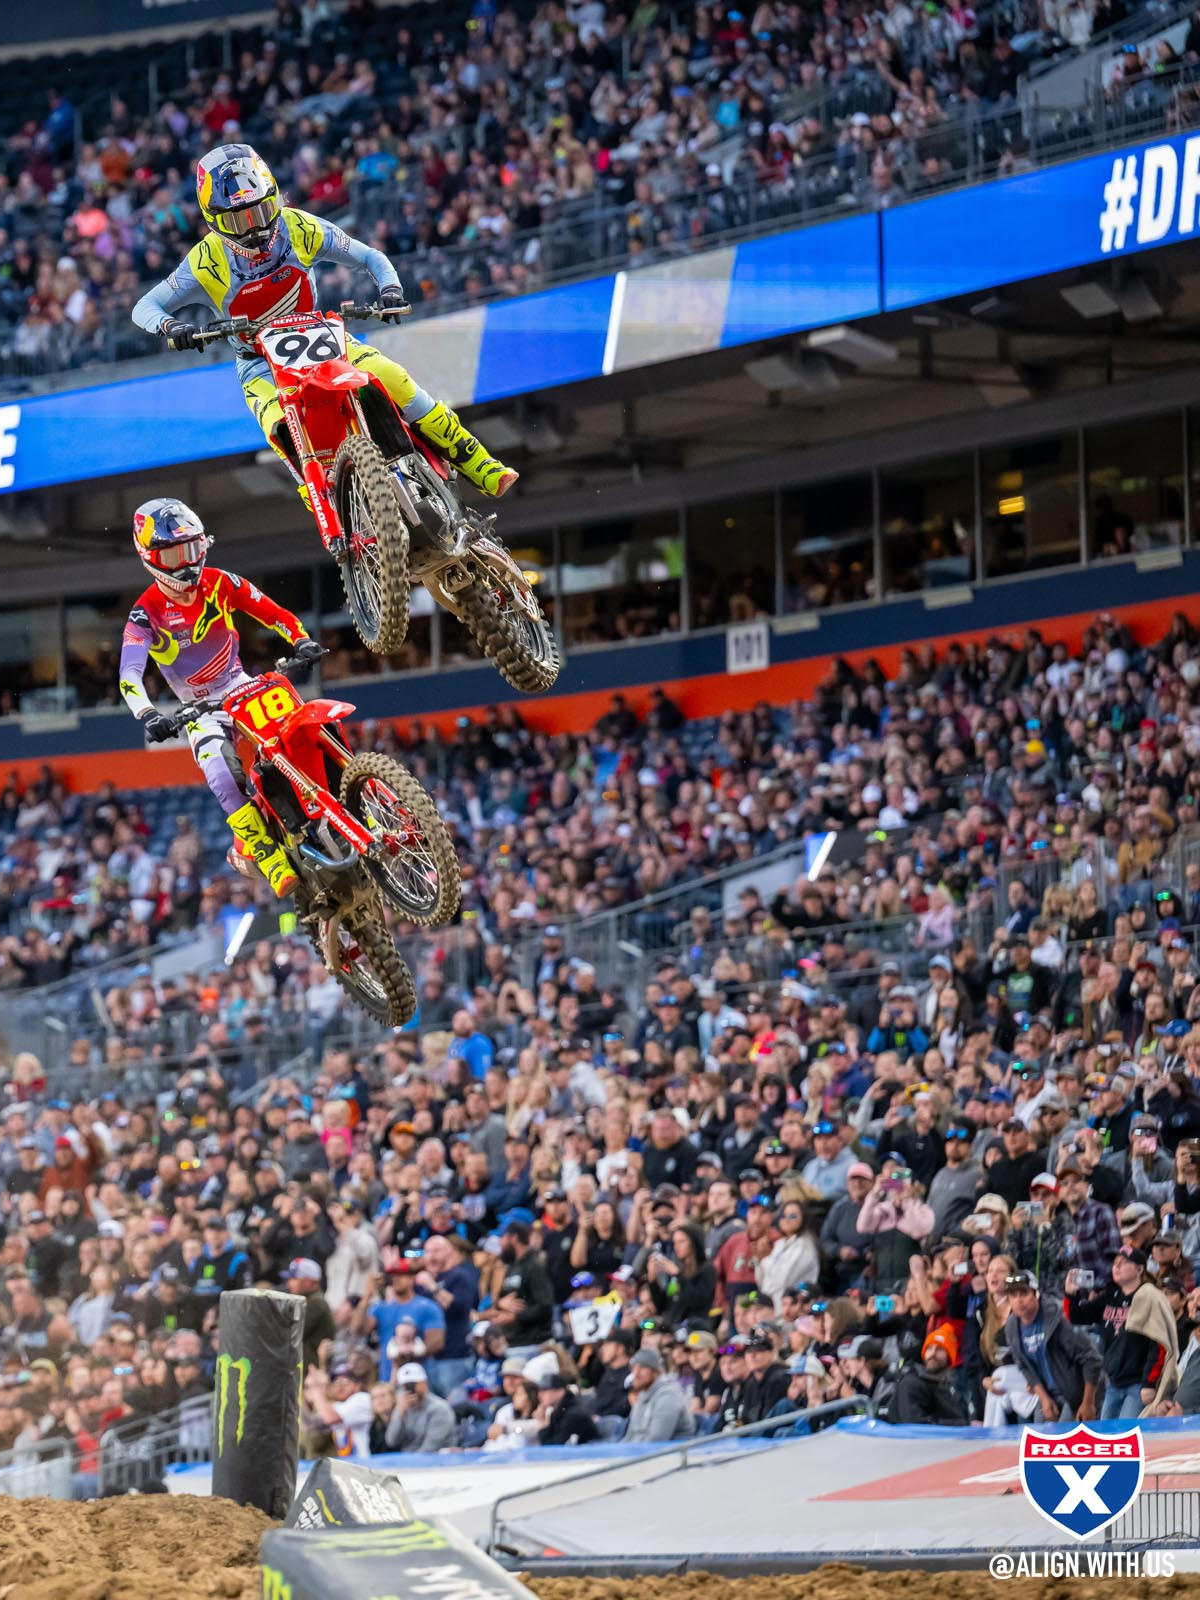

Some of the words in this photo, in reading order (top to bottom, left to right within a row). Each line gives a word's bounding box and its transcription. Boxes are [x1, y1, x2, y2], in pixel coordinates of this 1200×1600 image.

[274, 333, 341, 368] 96
[306, 481, 329, 529] DUNLOP
[245, 686, 296, 730] 18
[323, 807, 360, 842] DUNLOP
[587, 1311, 599, 1337] 3
